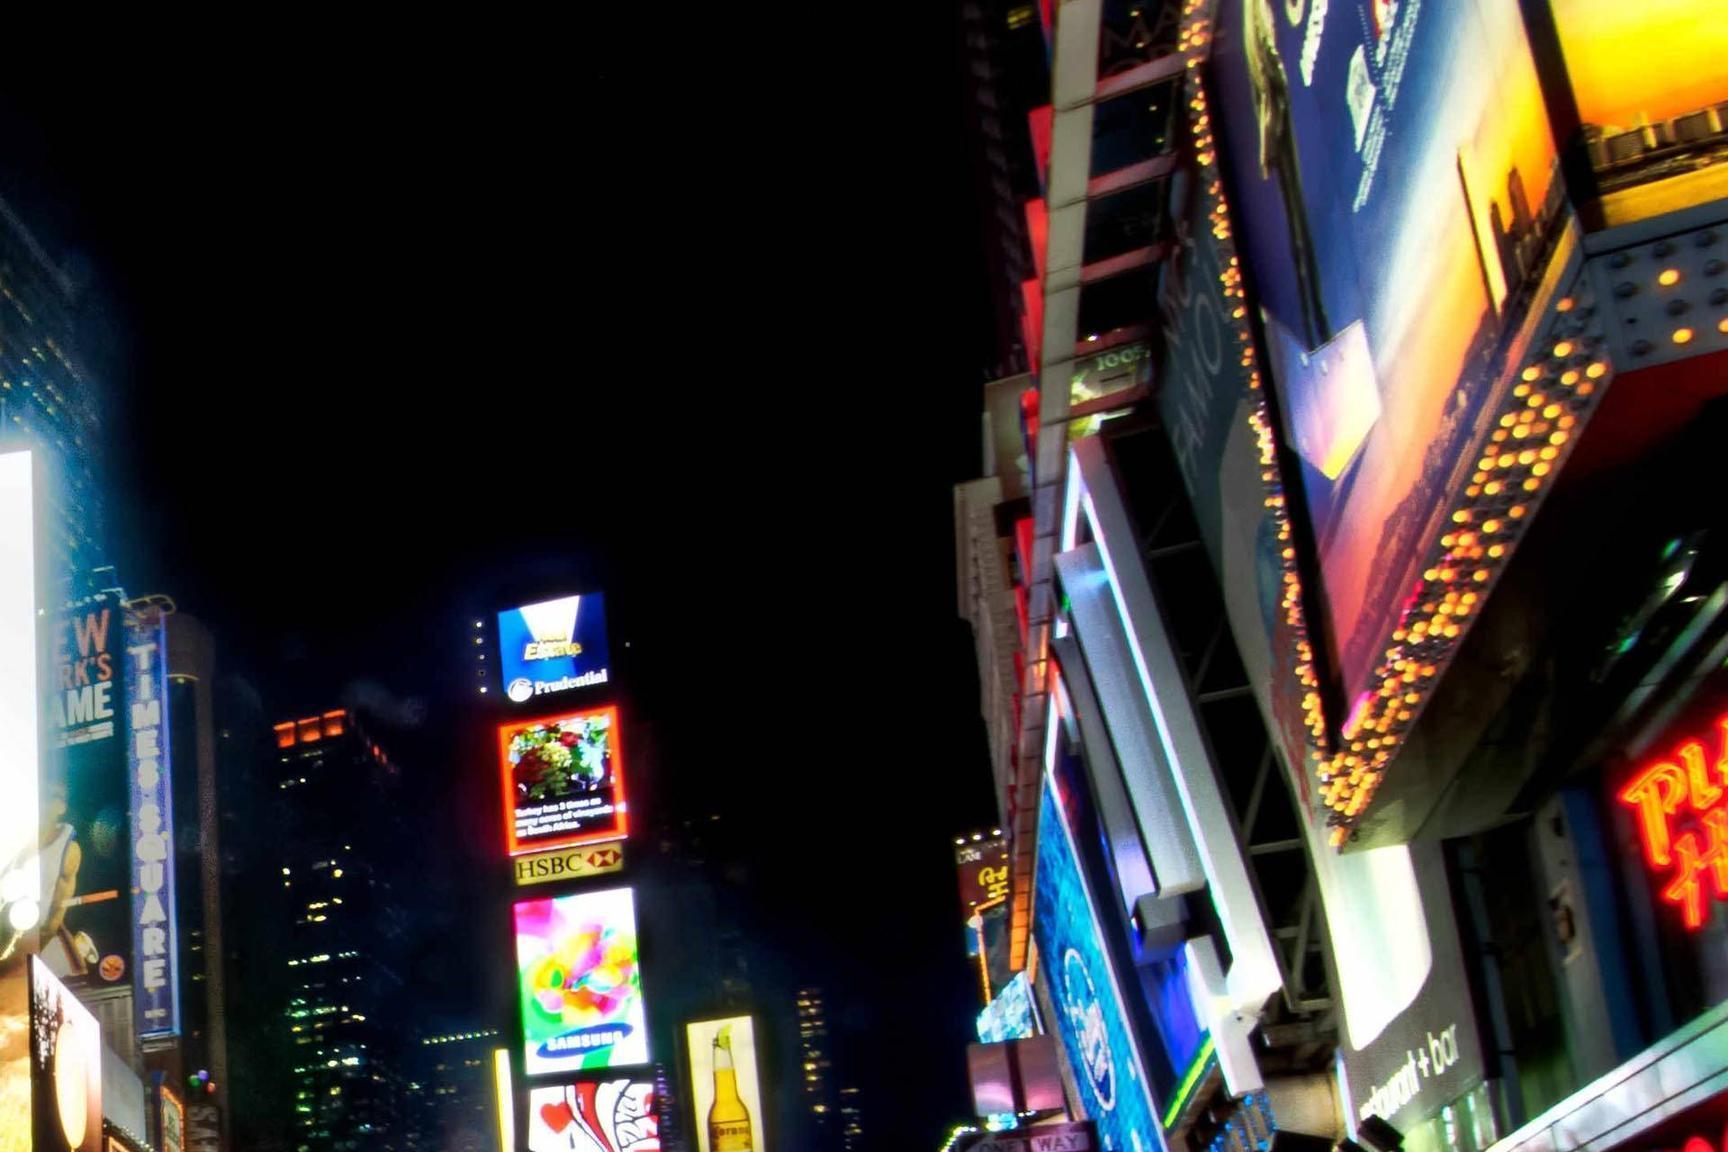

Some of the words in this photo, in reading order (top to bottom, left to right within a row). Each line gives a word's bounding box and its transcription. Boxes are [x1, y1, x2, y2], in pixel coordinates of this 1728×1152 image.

[48, 680, 115, 728] AME
[534, 668, 608, 695] Prudential
[517, 853, 582, 879] HSBC
[136, 804, 168, 988] SQUARE
[1427, 1023, 1460, 1076] bar
